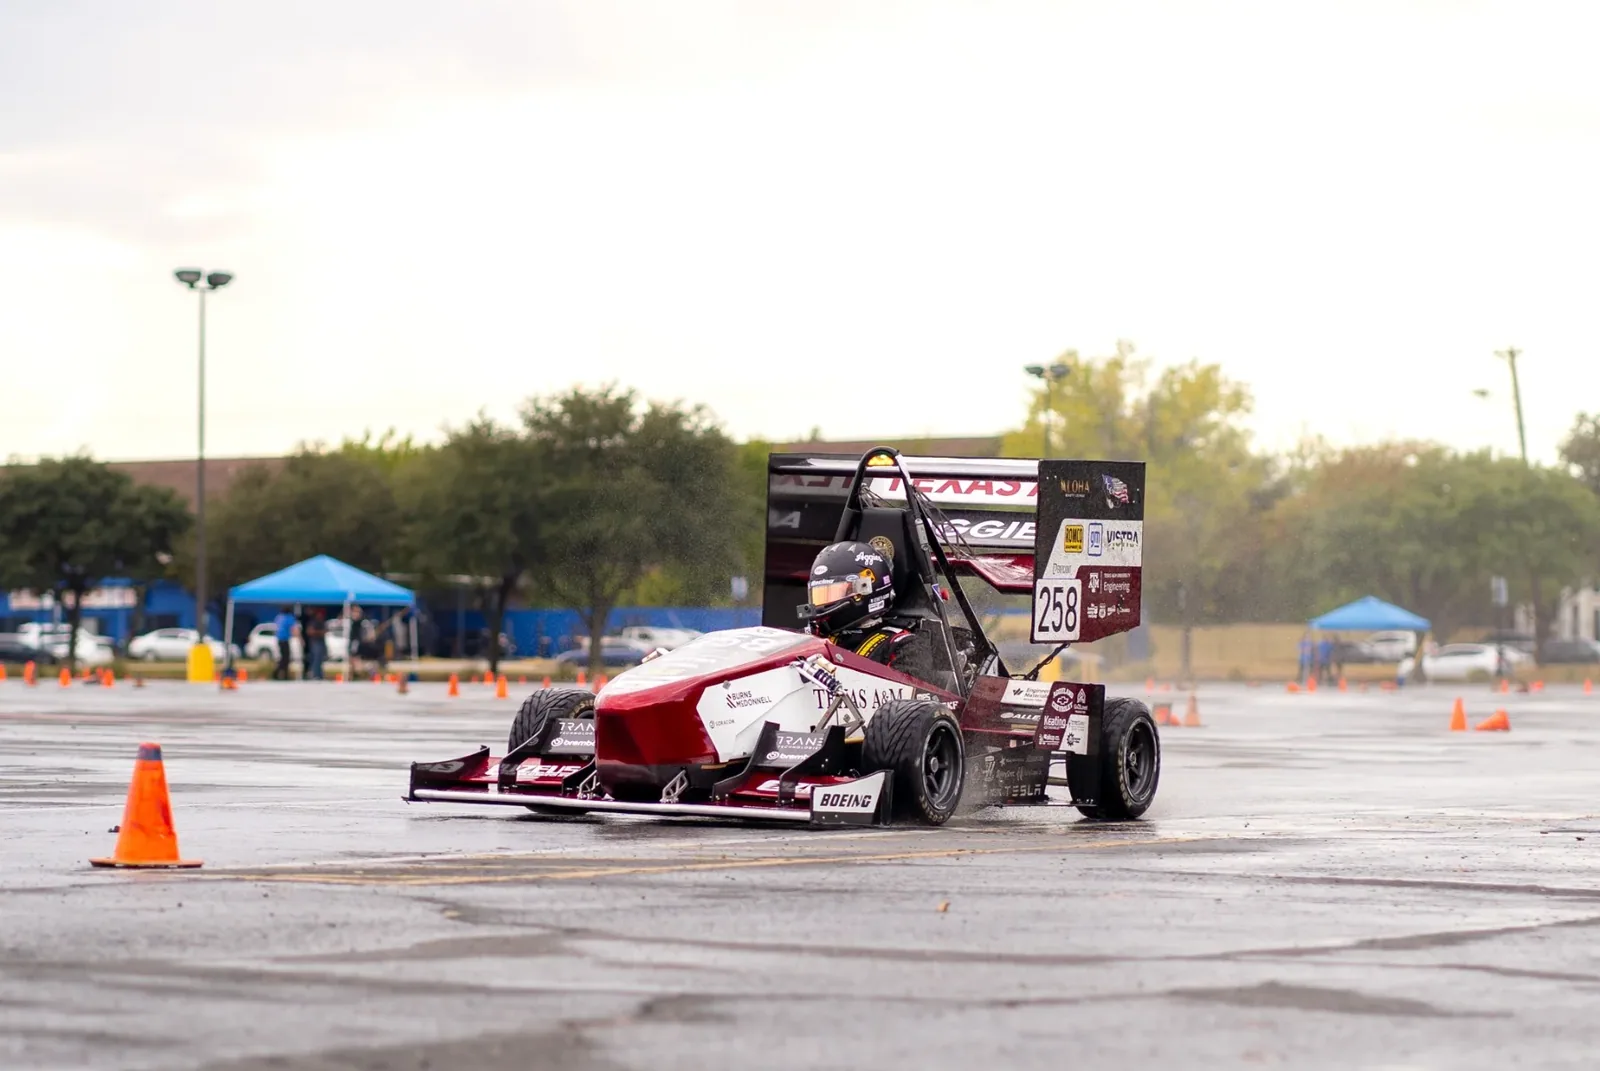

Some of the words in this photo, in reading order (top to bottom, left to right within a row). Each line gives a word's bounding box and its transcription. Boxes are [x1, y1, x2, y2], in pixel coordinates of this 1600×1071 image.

[888, 478, 1021, 497] TEXAS
[1103, 581, 1131, 593] Engineering
[1038, 586, 1077, 632] 258
[732, 691, 752, 700] BURNS
[813, 688, 867, 709] TEAS
[1043, 715, 1067, 729] Keating
[777, 736, 824, 747] TRANE
[1004, 784, 1042, 797] TESLA
[820, 794, 873, 808] BOEING
